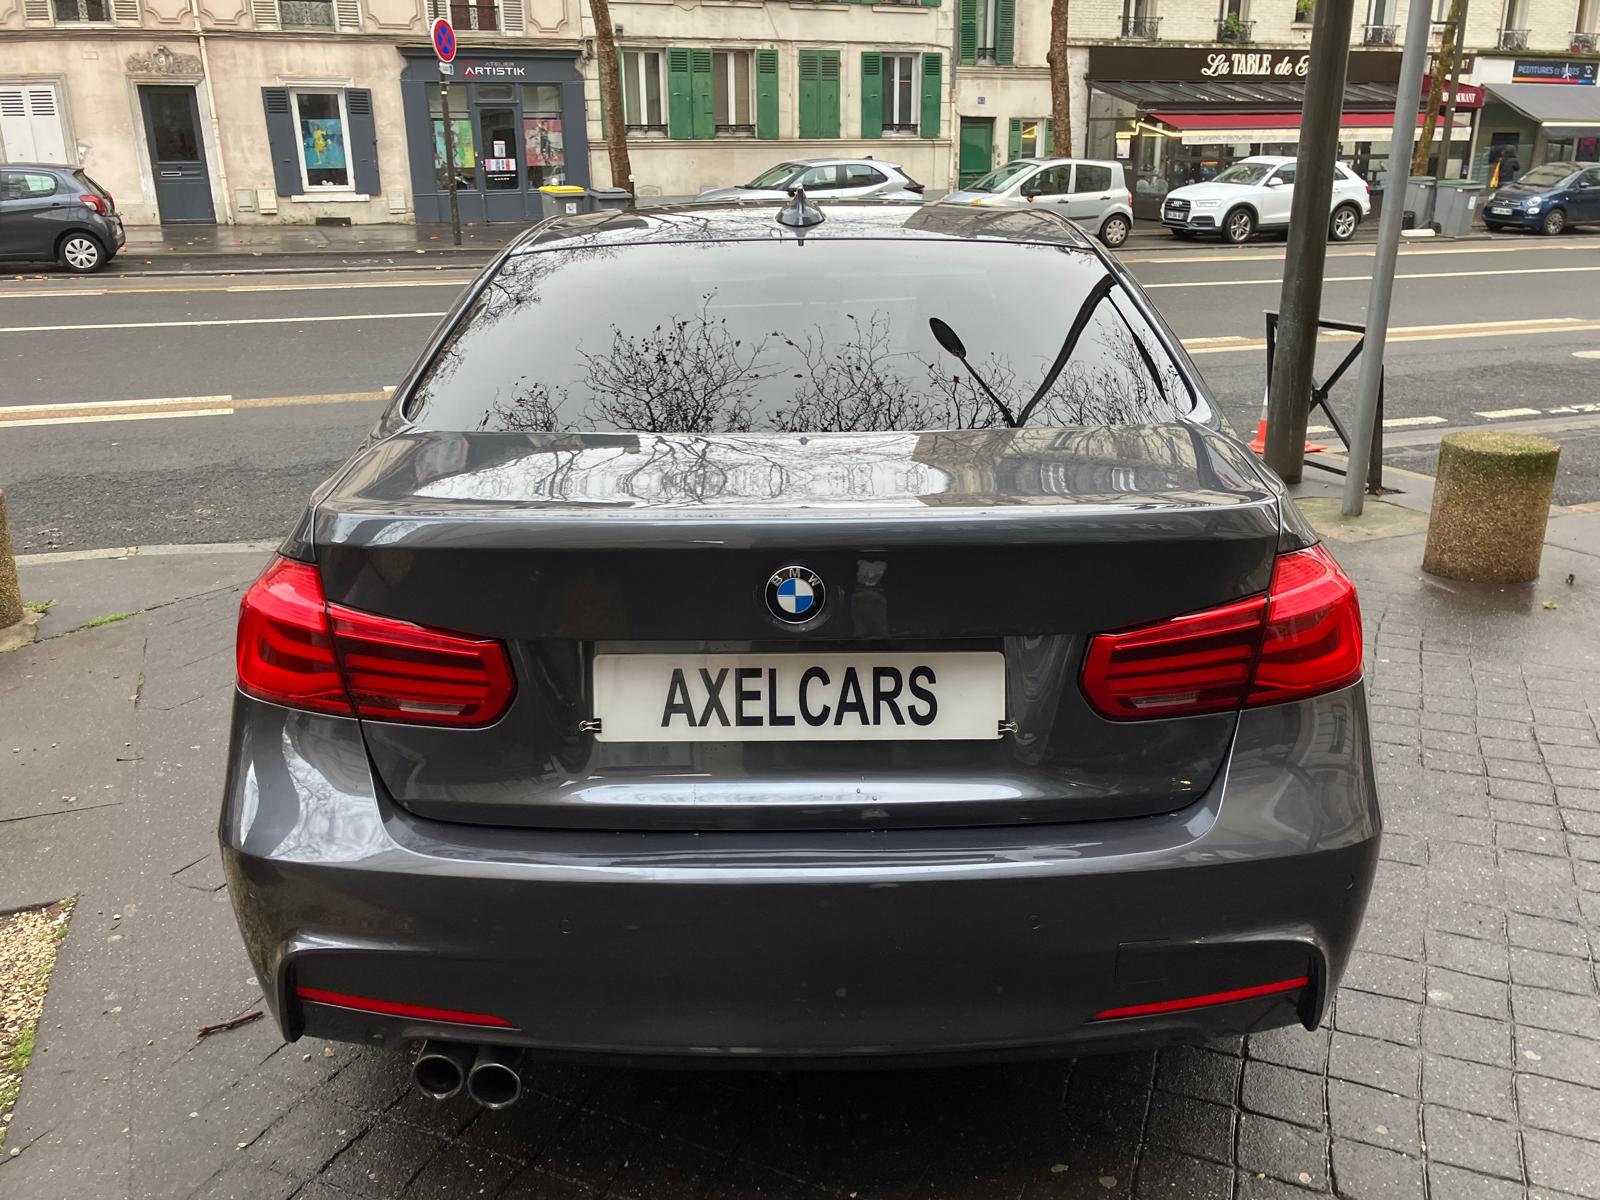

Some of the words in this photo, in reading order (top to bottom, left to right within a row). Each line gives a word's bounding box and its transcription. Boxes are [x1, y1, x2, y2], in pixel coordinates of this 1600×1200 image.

[464, 66, 526, 76] ARTISTIK
[1201, 53, 1230, 76] La
[1231, 53, 1272, 75] TABLE
[1274, 56, 1293, 76] de
[770, 568, 821, 587] BMW
[661, 665, 938, 728] AXELCARS
